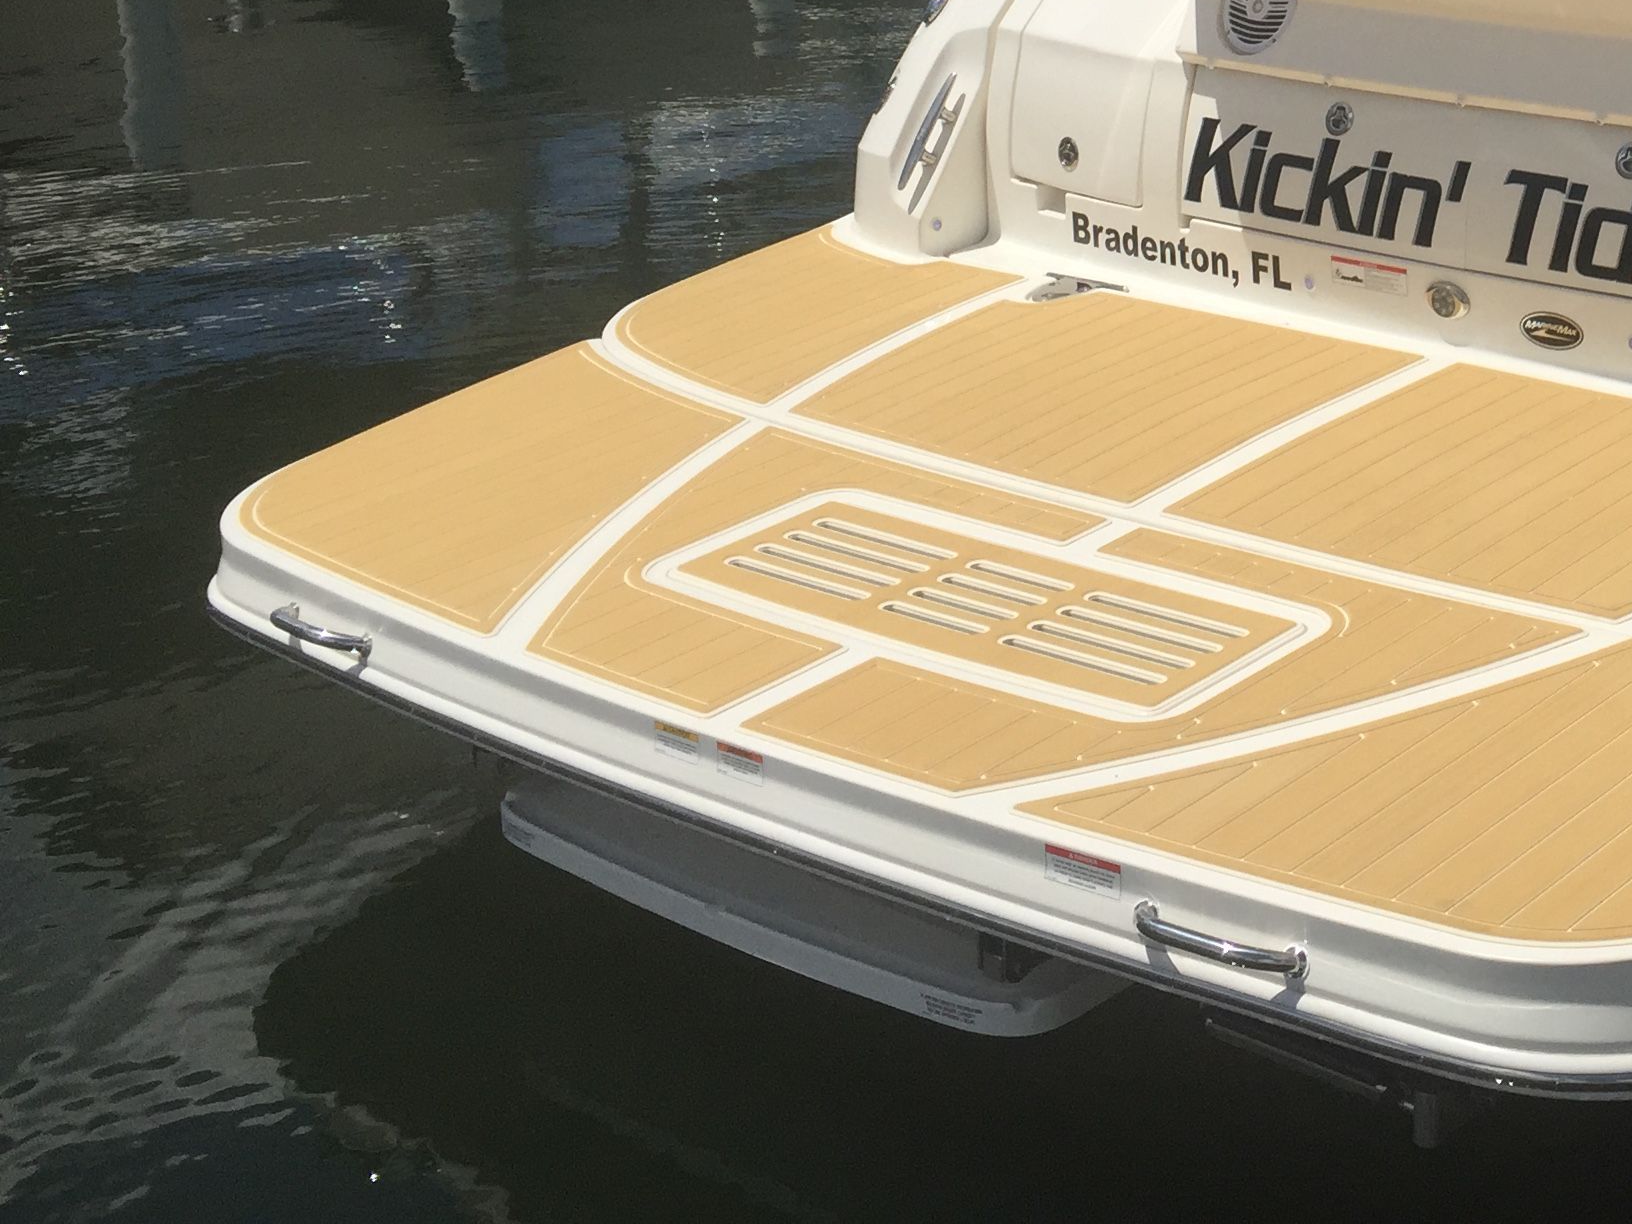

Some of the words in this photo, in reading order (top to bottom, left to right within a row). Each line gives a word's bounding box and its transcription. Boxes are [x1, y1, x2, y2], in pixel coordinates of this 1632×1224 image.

[1184, 117, 1472, 248] Kickin'
[1072, 211, 1240, 289] Bradenton,
[1251, 251, 1293, 291] FL
